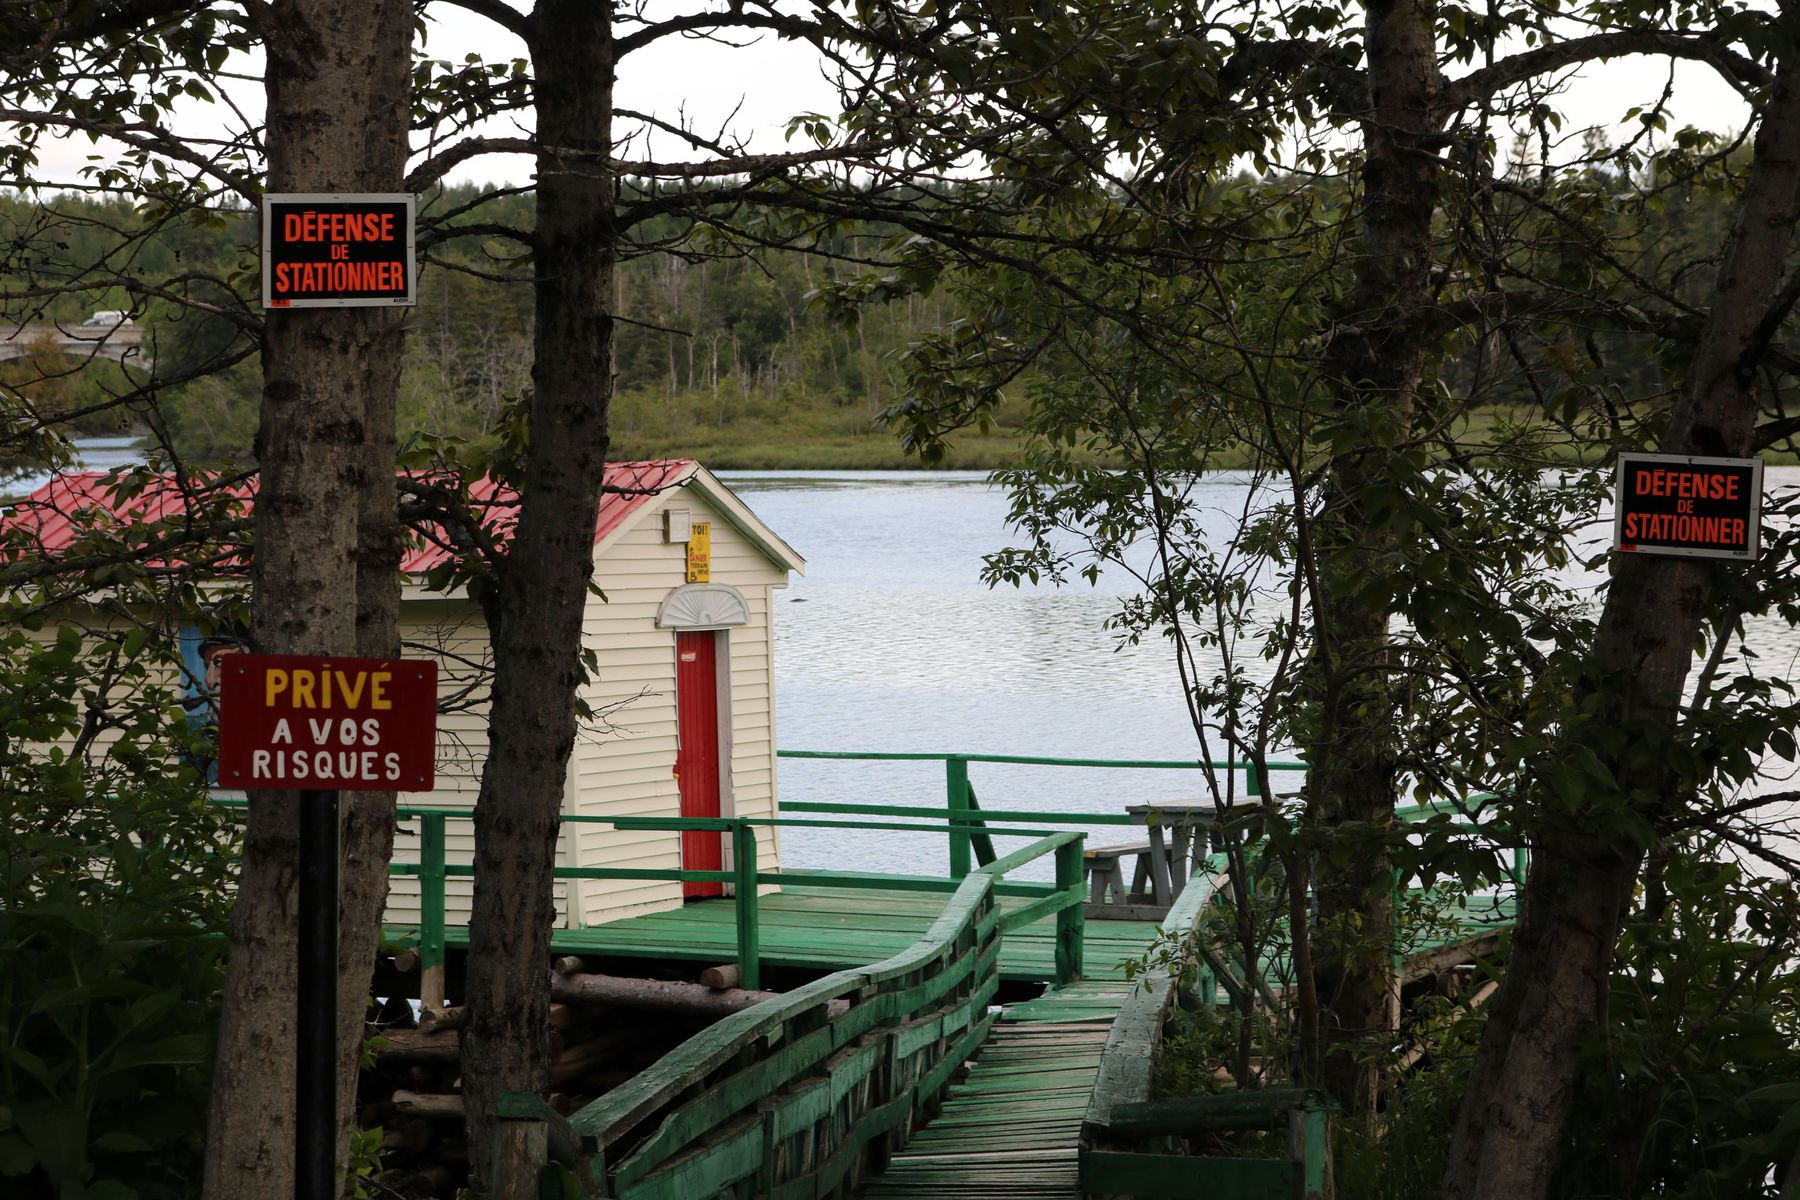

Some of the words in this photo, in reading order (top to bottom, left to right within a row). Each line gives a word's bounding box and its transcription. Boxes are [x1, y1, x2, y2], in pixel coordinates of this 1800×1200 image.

[285, 211, 394, 242] DÉFENSE
[331, 244, 349, 260] DE
[275, 262, 404, 293] STATIONNER
[1635, 469, 1739, 500] DÉFENSE
[1677, 500, 1694, 514] DE
[1625, 512, 1744, 545] STATIONNER
[265, 662, 392, 710] PRIVÉ
[271, 718, 293, 744] A
[308, 717, 380, 746] VOS
[252, 750, 401, 781] RISQUES
